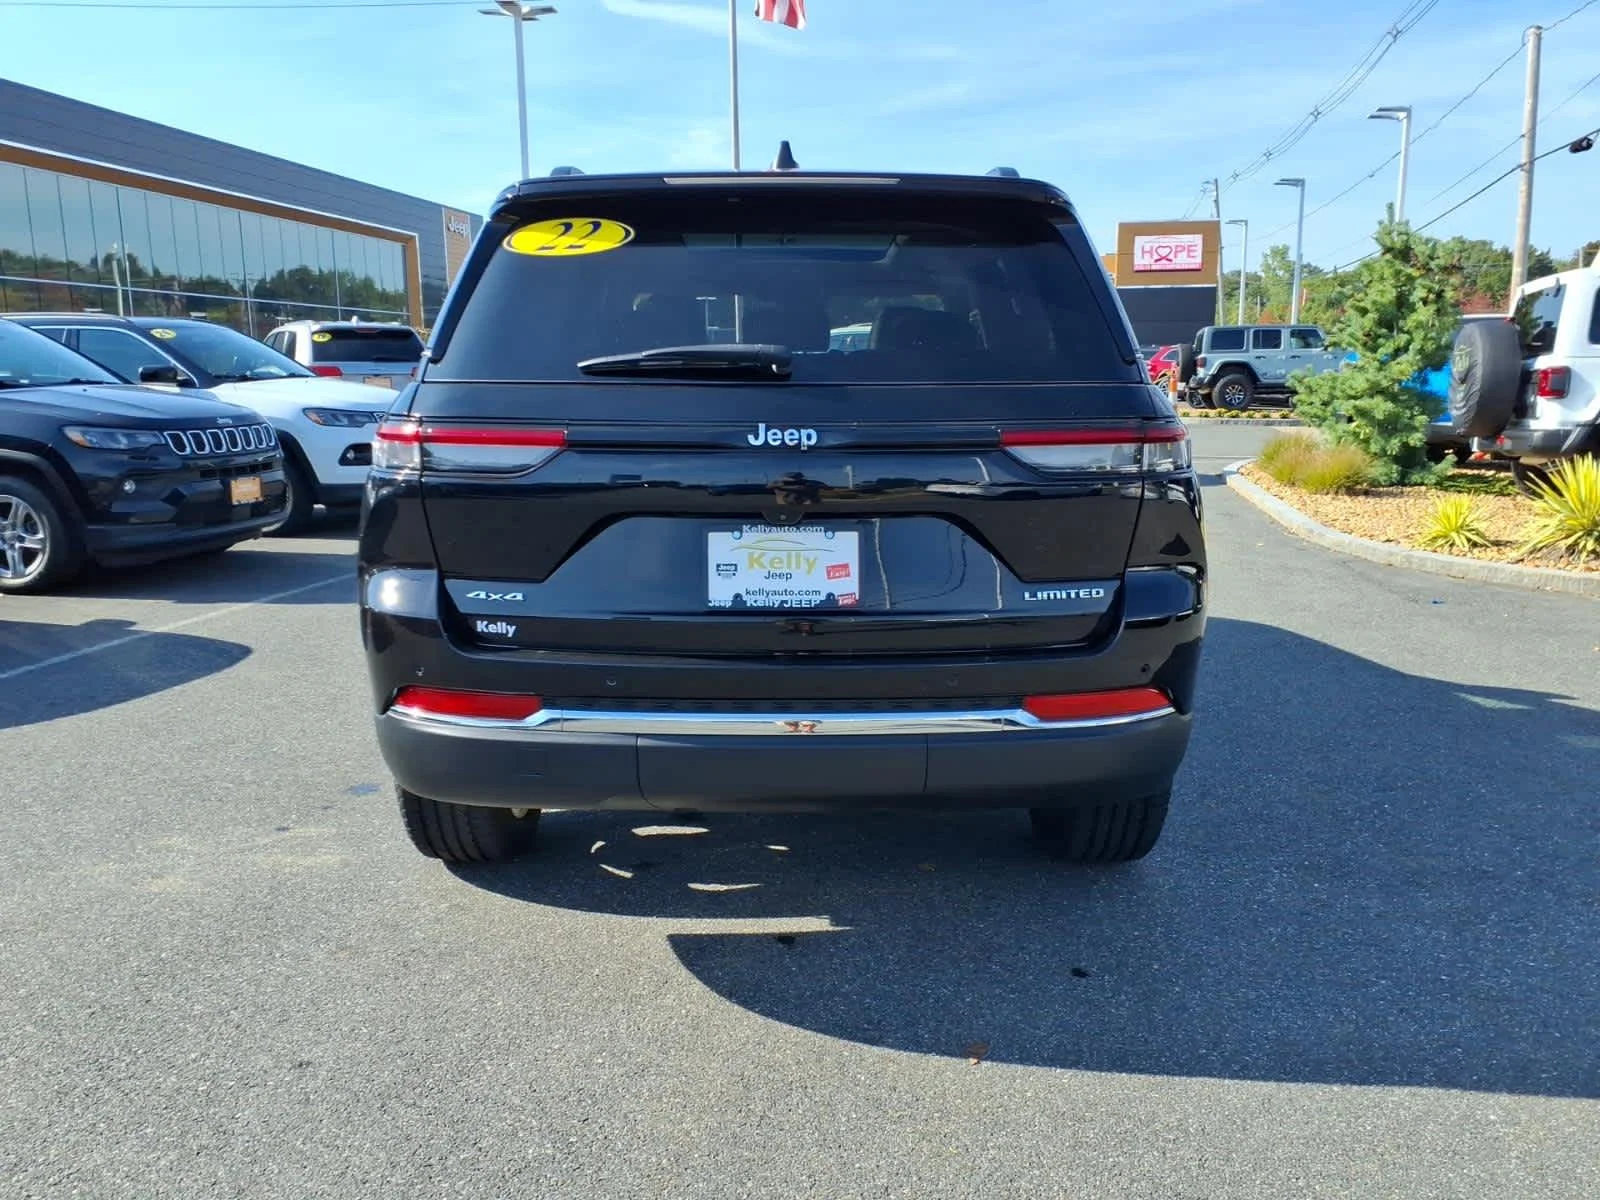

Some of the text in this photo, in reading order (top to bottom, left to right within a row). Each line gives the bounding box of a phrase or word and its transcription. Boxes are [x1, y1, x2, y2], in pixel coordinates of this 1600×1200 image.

[447, 215, 467, 239] Jeep
[535, 221, 602, 250] 22
[1141, 244, 1198, 262] HOPE
[747, 423, 817, 451] Jeep
[743, 525, 825, 534] Kellyauto.com
[748, 552, 818, 575] Kelly
[764, 571, 793, 582] Jeep
[465, 590, 524, 601] 4x4
[745, 587, 821, 598] kellyauto.com
[1024, 588, 1104, 601] LIMITED
[708, 599, 732, 608] Jeep
[746, 599, 821, 608] Kelly JEEP
[476, 620, 517, 637] Kelly
